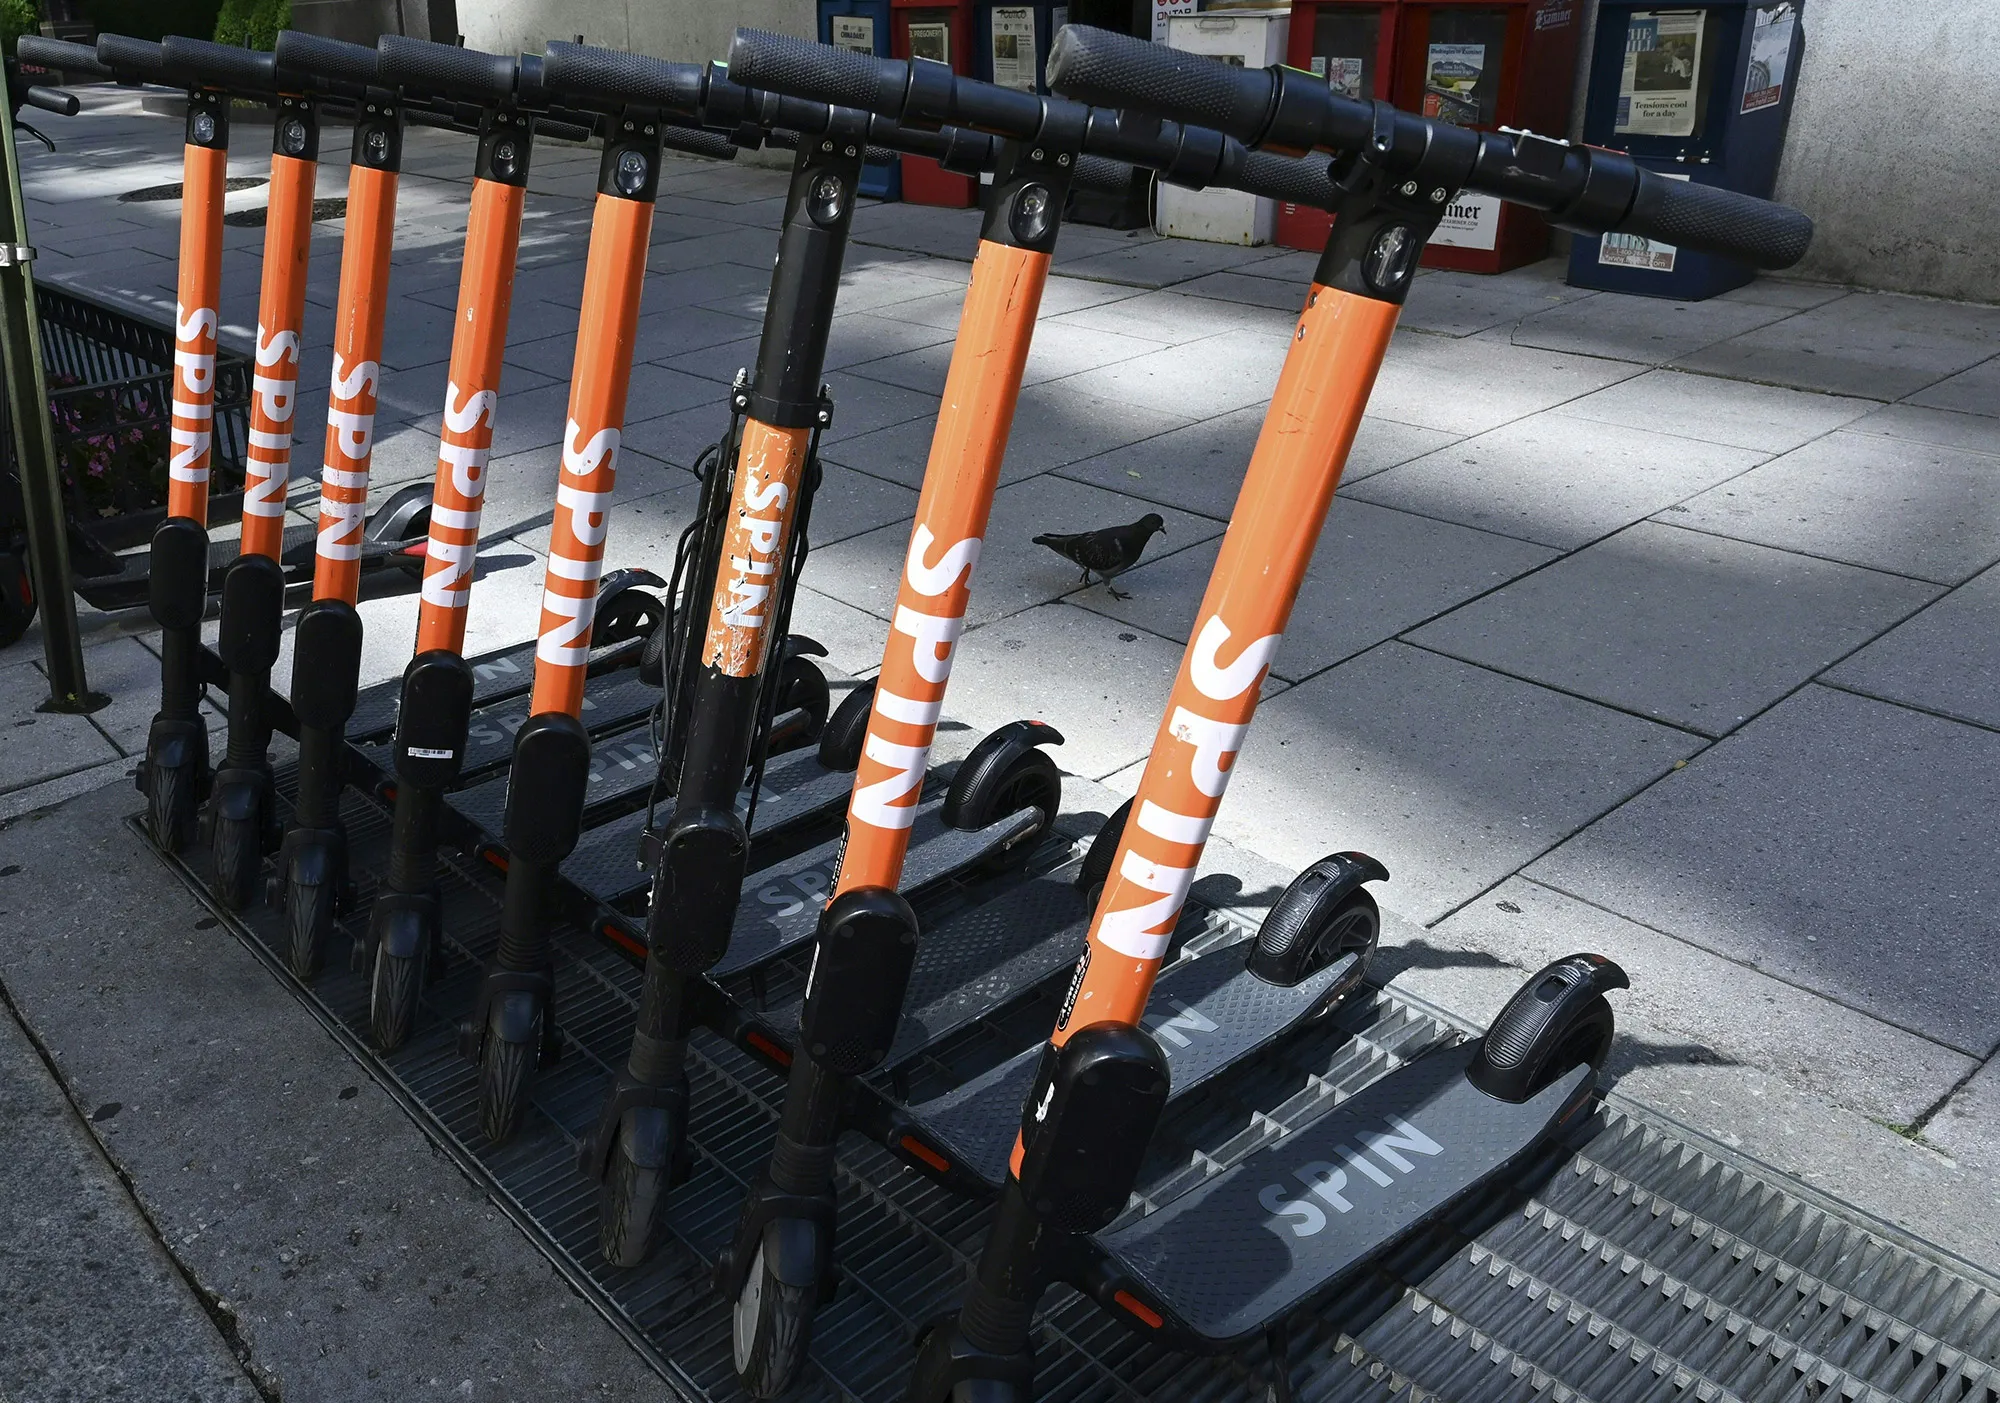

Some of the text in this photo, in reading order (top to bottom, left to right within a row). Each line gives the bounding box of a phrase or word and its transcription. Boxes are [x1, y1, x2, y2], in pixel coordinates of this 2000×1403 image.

[1628, 28, 1652, 40] HE
[1634, 100, 1688, 109] Tensions cool
[1662, 109, 1677, 118] day
[169, 300, 218, 482] SPIN
[243, 322, 300, 517] SPIN
[316, 351, 380, 561] SPIN
[421, 380, 497, 608] SPIN
[537, 417, 621, 666] SPIN
[723, 476, 789, 628] SPIN
[851, 523, 983, 829] SPIN
[1096, 614, 1282, 959] SPIN
[1070, 967, 1086, 1005] POWERED
[1258, 1113, 1444, 1237] SPIN
